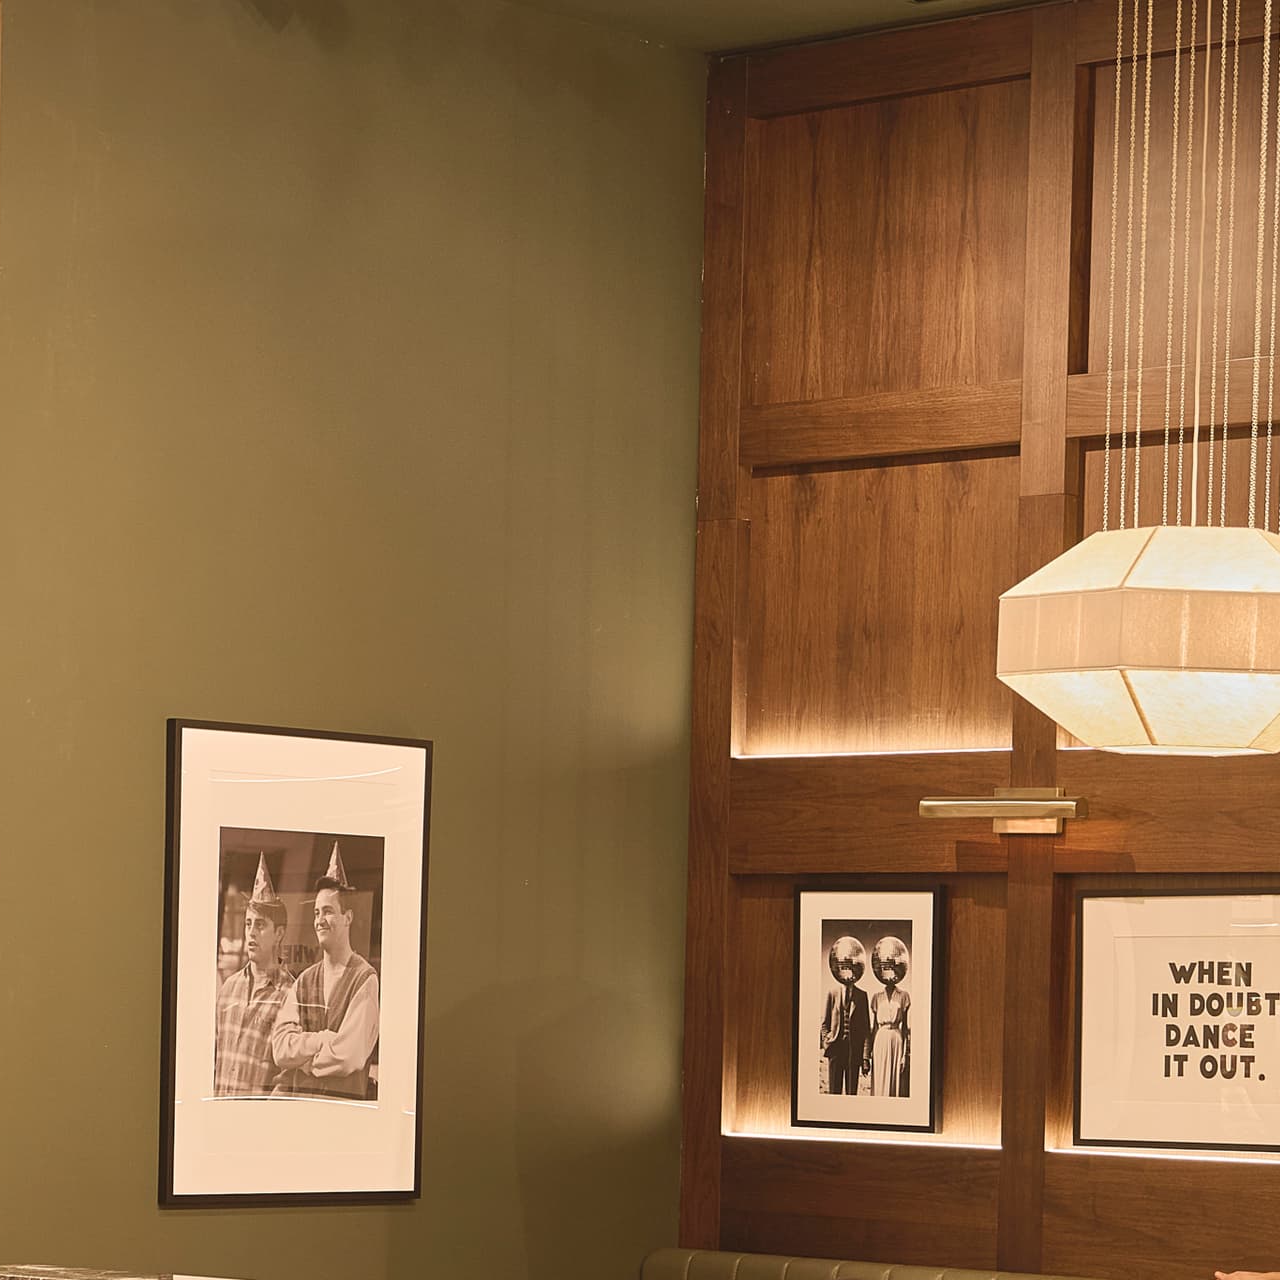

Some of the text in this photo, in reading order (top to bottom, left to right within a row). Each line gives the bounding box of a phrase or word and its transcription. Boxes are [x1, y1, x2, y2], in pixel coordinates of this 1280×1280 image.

[1168, 961, 1252, 987] WHEN
[1152, 992, 1280, 1017] IN DOUBT
[1166, 1023, 1254, 1048] DANCE
[1164, 1054, 1265, 1080] IT OUT.
